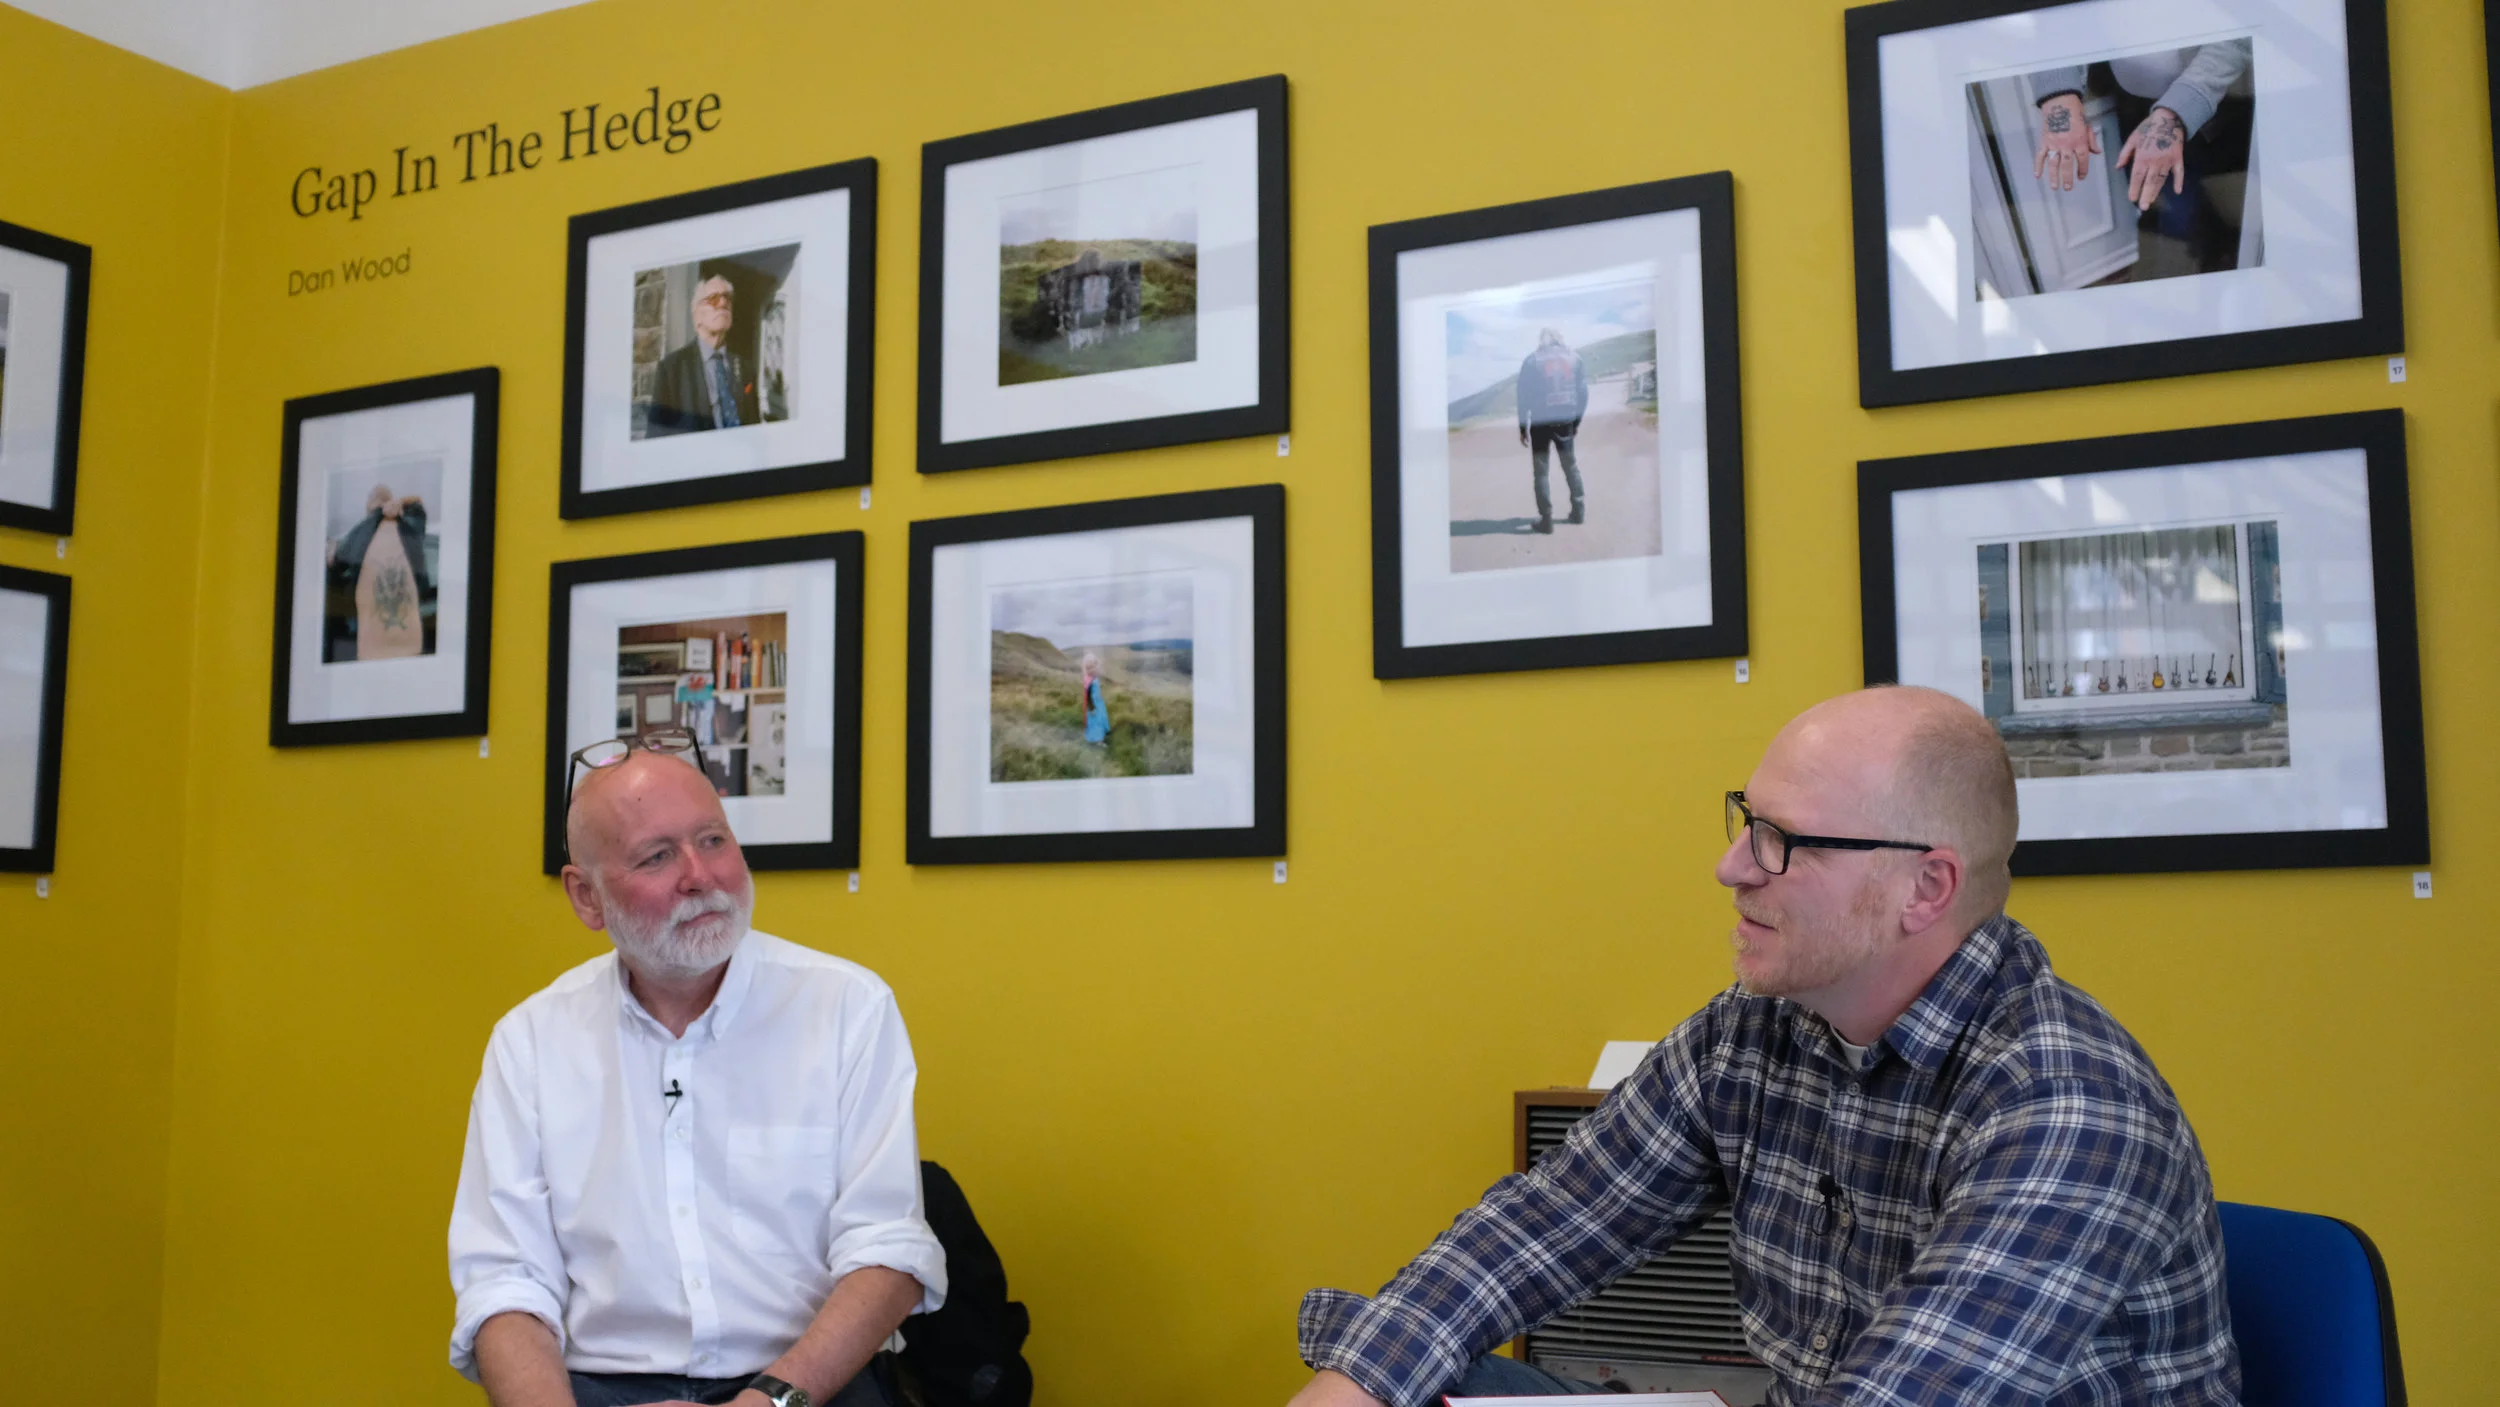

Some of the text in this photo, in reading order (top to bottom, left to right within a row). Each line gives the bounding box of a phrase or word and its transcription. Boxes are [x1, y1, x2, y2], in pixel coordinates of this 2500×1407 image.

[290, 85, 723, 221] Gap In The Hedge
[287, 247, 412, 297] Dan Wood
[2392, 365, 2403, 376] 17
